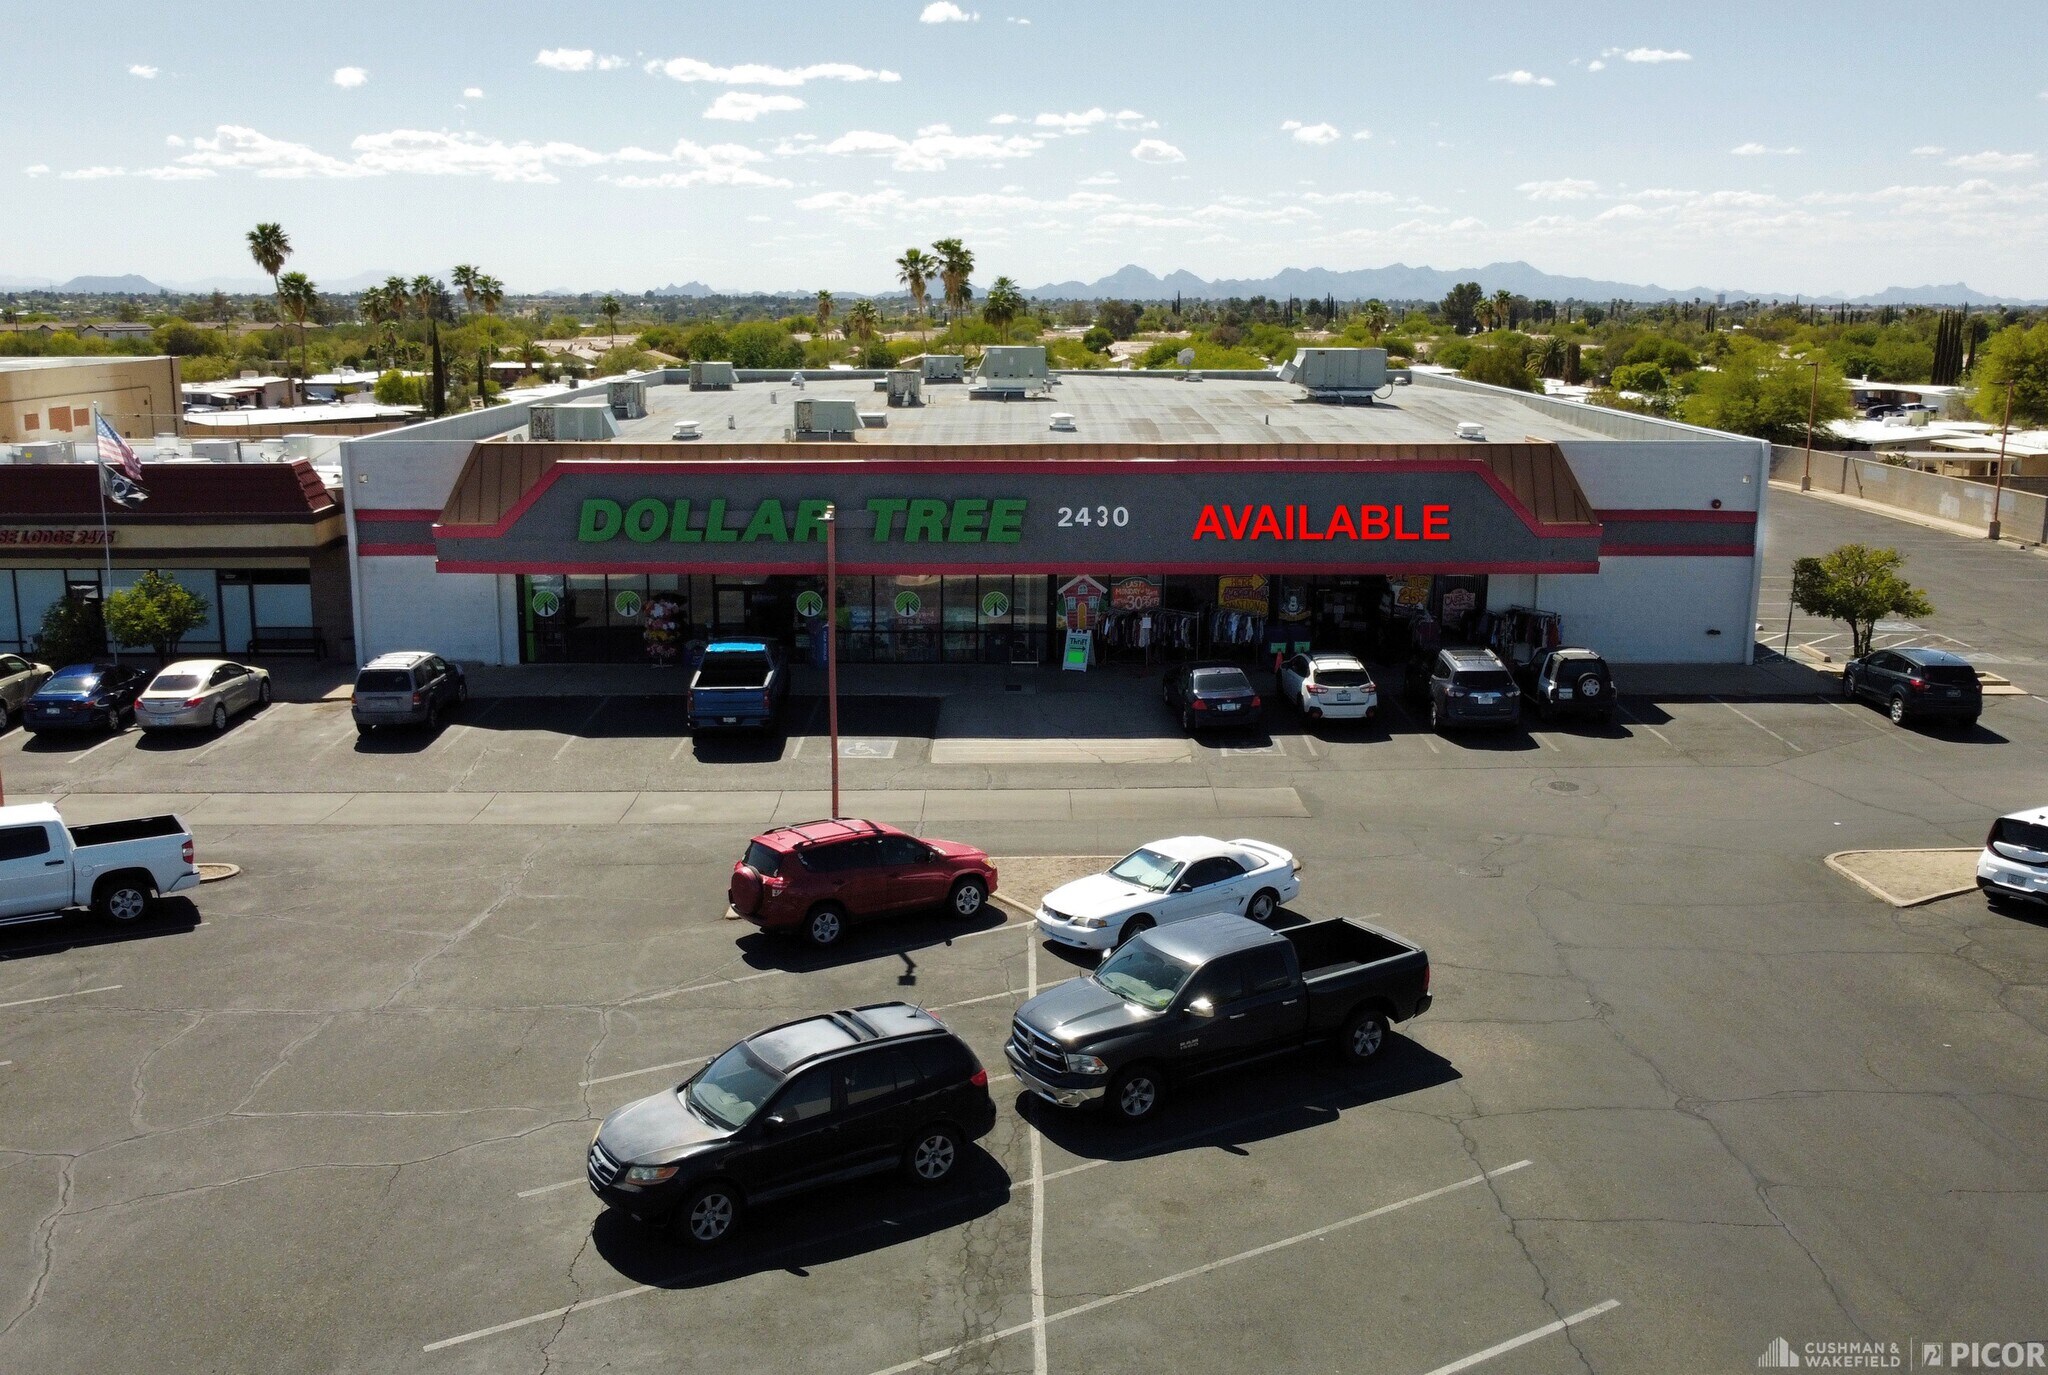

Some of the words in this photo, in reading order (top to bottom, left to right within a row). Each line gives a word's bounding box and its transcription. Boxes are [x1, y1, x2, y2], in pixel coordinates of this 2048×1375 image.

[578, 499, 830, 543] DOLLAR
[868, 498, 1027, 543] TREE
[1058, 506, 1129, 527] 2430
[20, 530, 75, 544] LODGE
[1126, 581, 1142, 589] LAST
[1179, 1038, 1199, 1046] RAM
